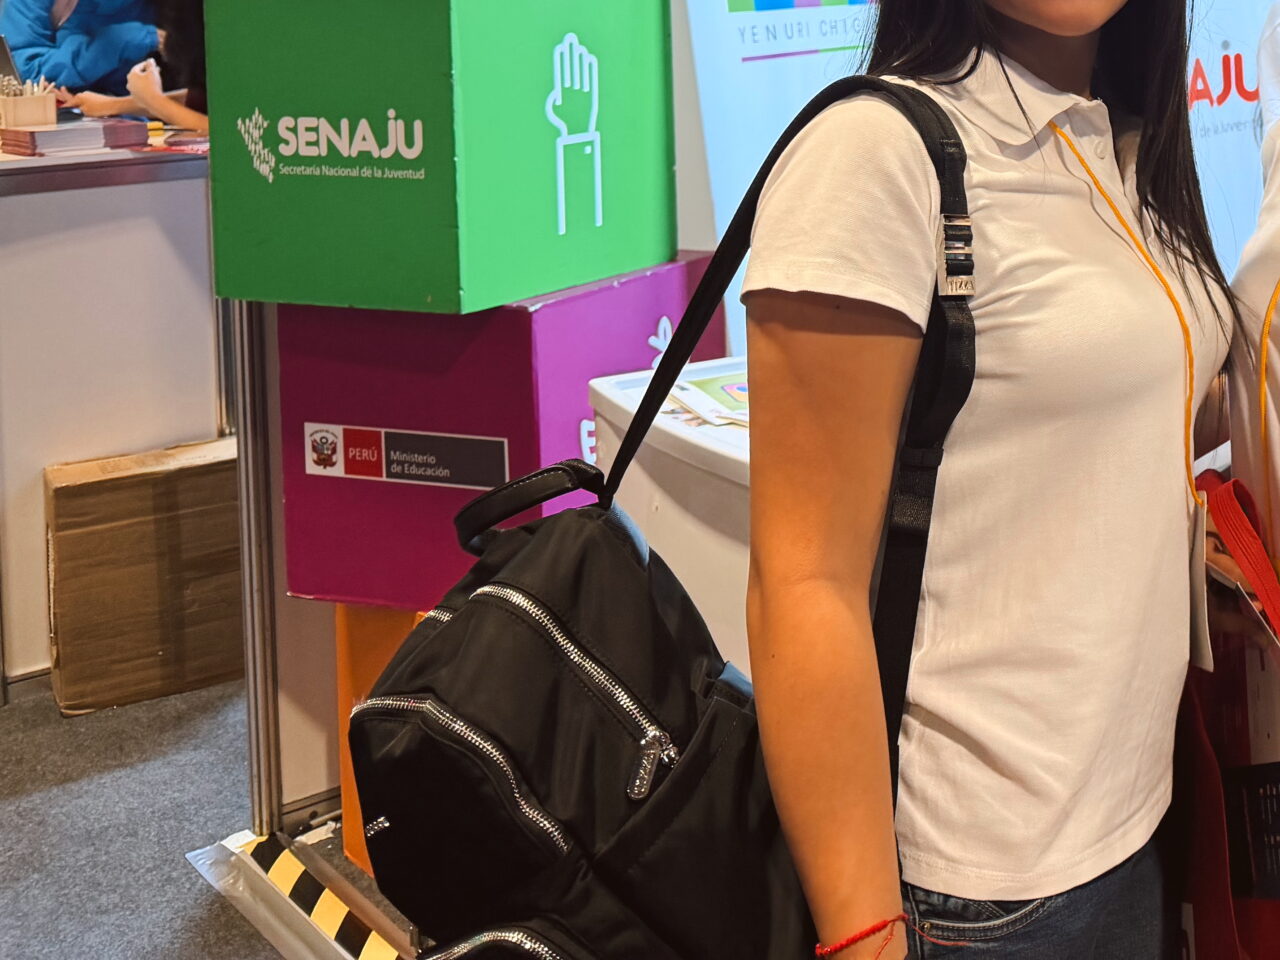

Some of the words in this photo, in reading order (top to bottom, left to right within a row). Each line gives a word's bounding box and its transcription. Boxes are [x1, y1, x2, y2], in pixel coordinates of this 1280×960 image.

[1187, 40, 1260, 112] AJU
[321, 165, 360, 177] Nacional
[361, 166, 373, 177] de
[374, 165, 382, 178] la
[383, 168, 425, 180] Juventud
[349, 446, 377, 462] PERÚ
[390, 450, 436, 464] Ministerio
[391, 462, 402, 474] de
[404, 463, 450, 478] Educación
